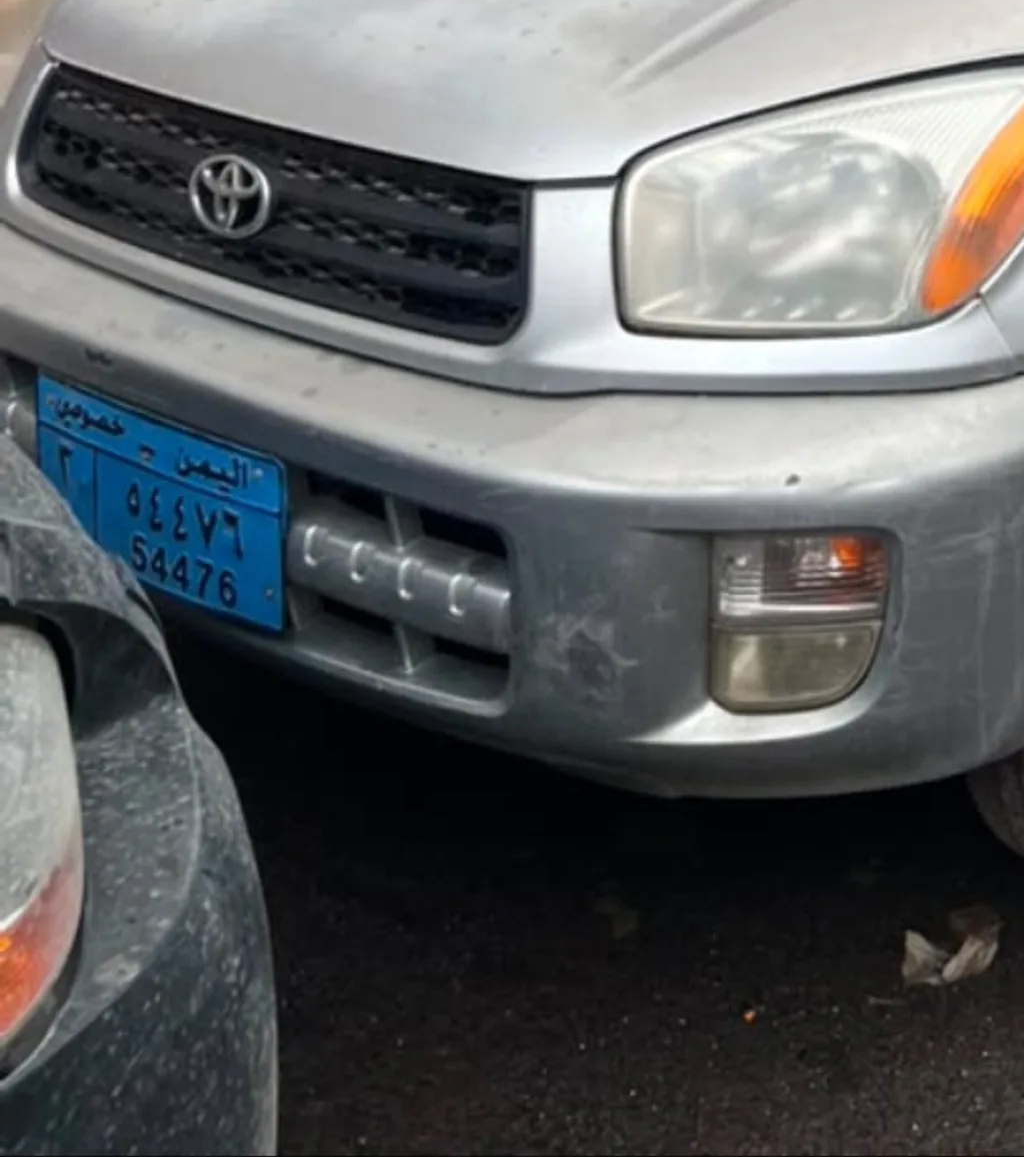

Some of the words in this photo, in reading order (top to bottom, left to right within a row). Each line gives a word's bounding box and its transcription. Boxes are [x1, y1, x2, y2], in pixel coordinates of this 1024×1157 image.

[177, 448, 248, 492] اليمن
[127, 481, 244, 561] ٥٤٤٧٦
[131, 534, 237, 607] 54476
